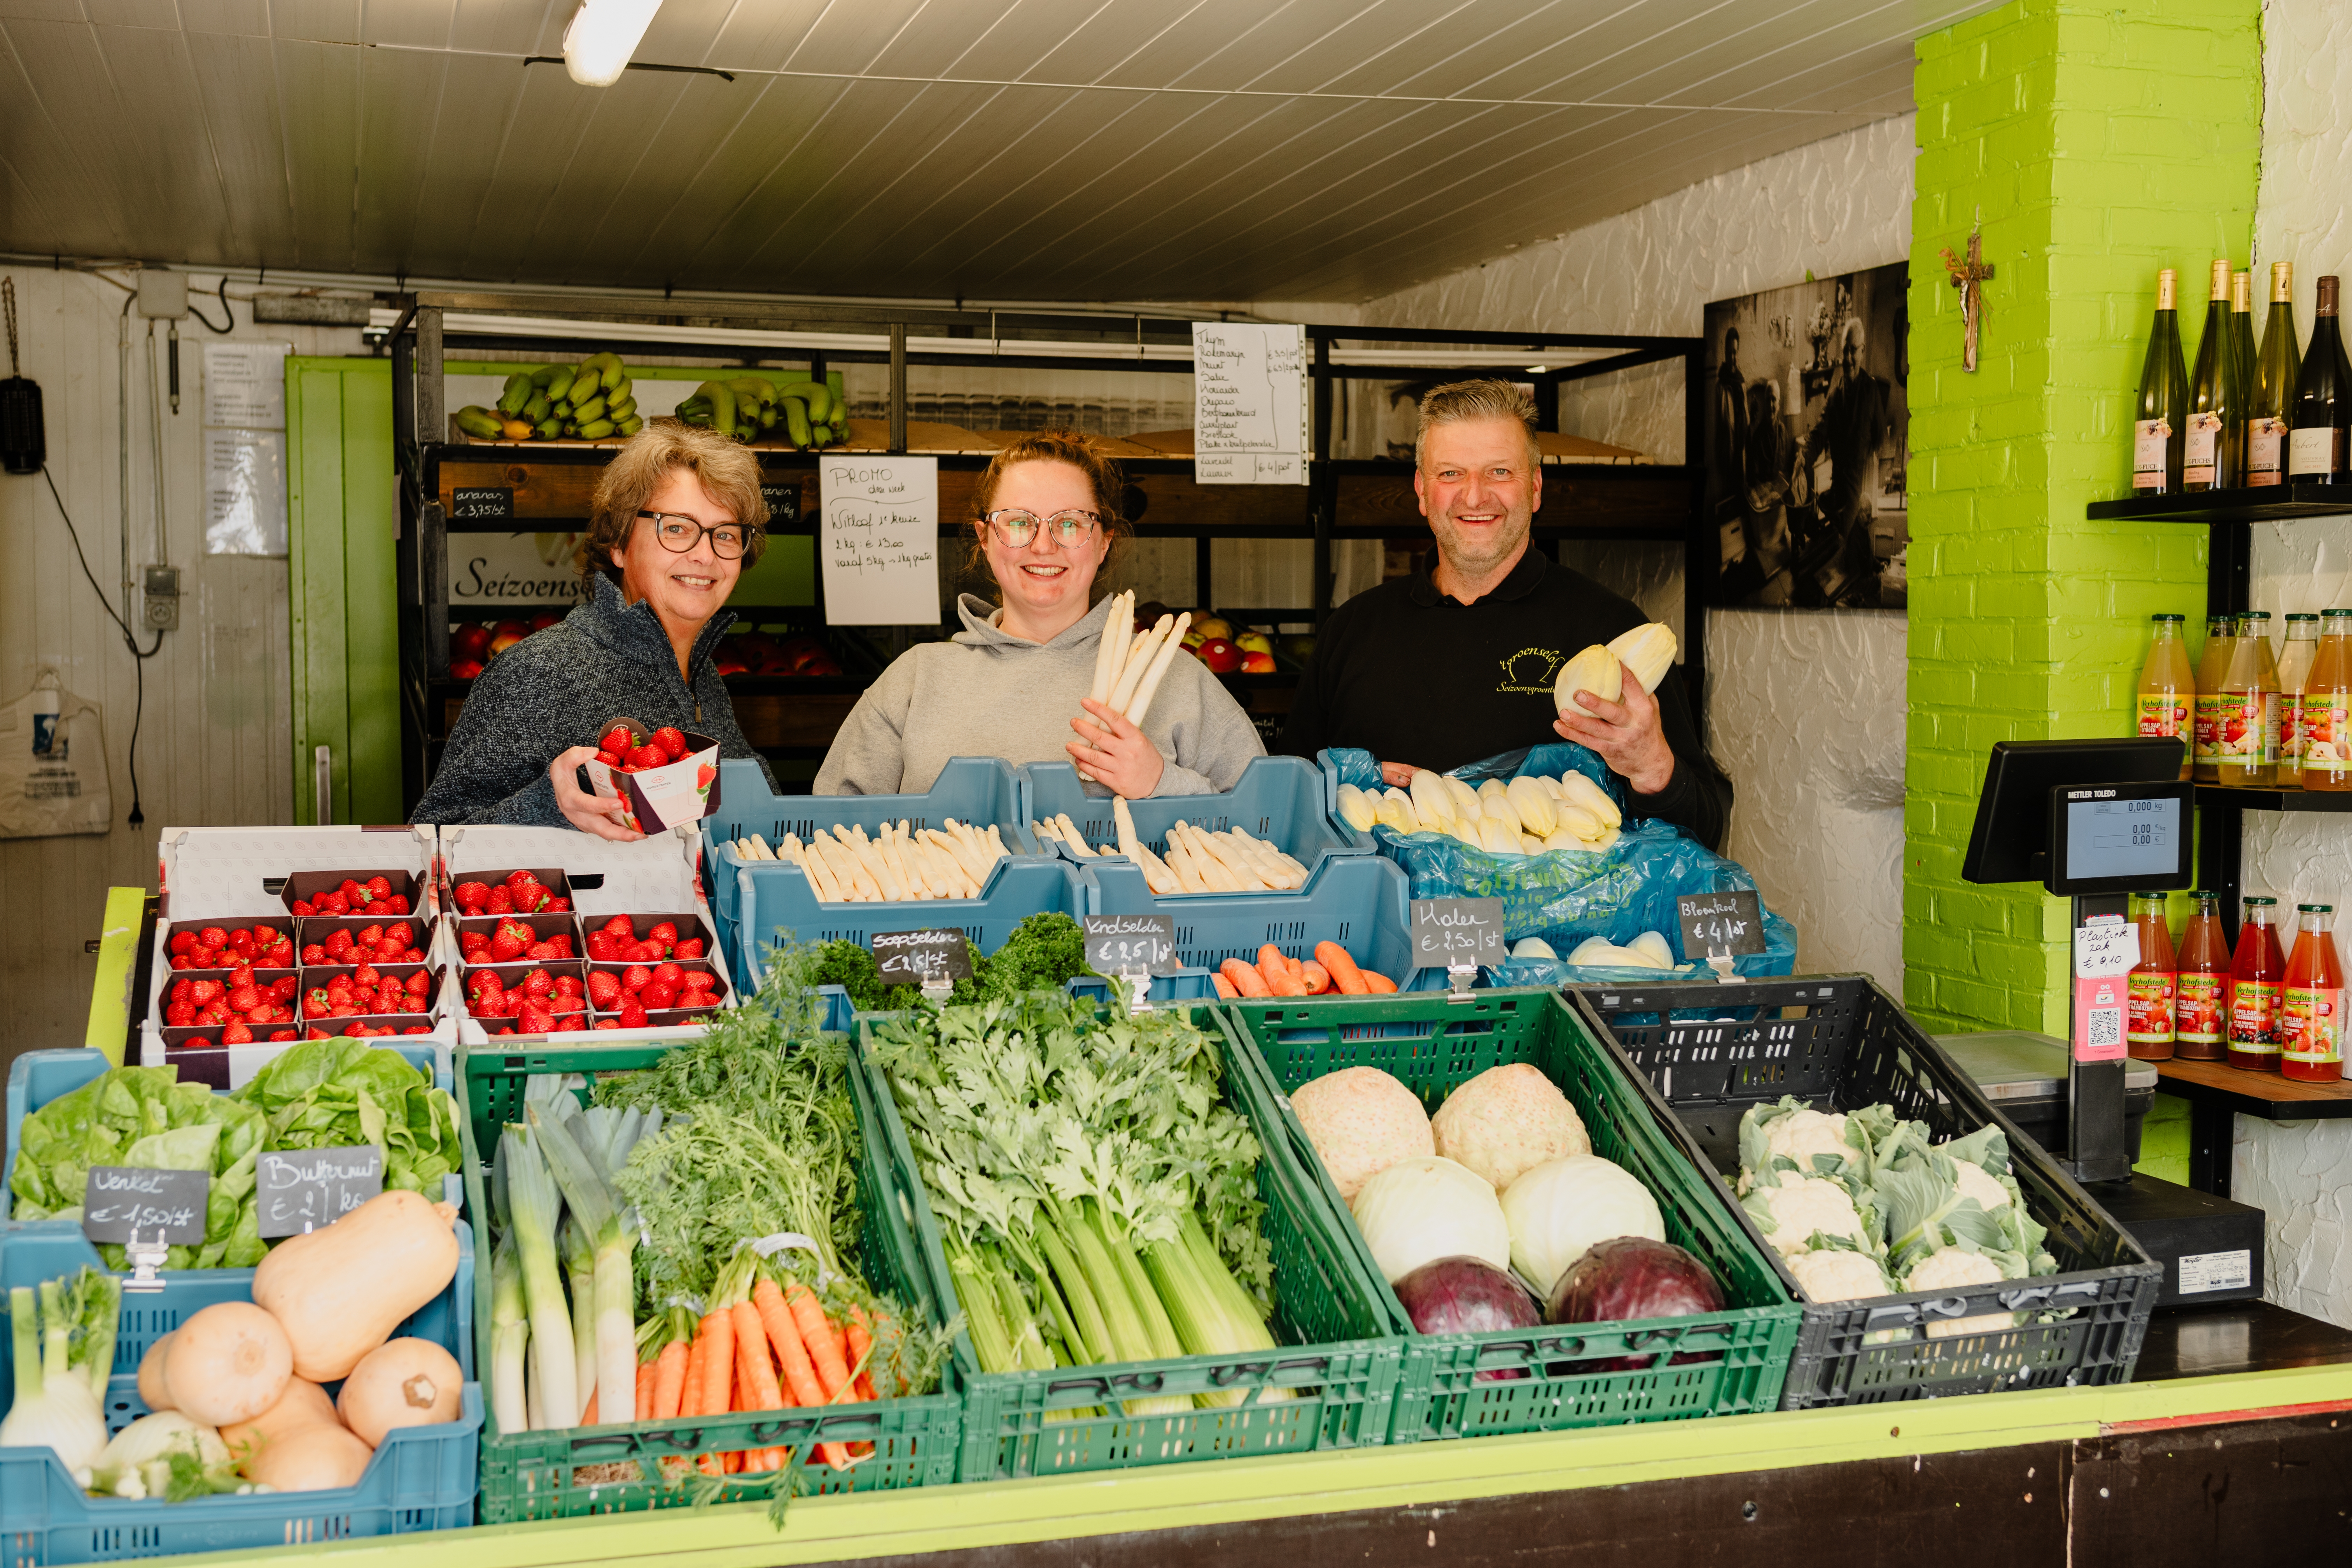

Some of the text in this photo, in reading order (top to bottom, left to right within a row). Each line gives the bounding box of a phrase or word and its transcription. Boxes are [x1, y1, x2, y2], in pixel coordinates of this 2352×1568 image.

[1200, 371, 1229, 381] Salie
[1200, 383, 1240, 394] Koriander
[830, 467, 892, 486] PROMO
[456, 492, 504, 500] ananas
[831, 509, 873, 536] Witloof
[2142, 700, 2177, 708] Verhofstede
[2129, 802, 2151, 812] 0,000
[2133, 824, 2151, 834] 0,00
[2133, 835, 2150, 845] 0,00
[1420, 902, 1489, 927] Kolen
[1085, 915, 1165, 934] Knolselder
[2078, 925, 2129, 942] Plastiek
[1421, 934, 1440, 952] €
[1098, 941, 1113, 961] €
[2083, 956, 2094, 968] €
[2130, 977, 2165, 988] Verhofstede
[2179, 977, 2214, 988] Verhofstede
[2237, 986, 2274, 995] Verhofstede
[2286, 992, 2320, 1002] Verhofstede
[264, 1155, 380, 1190] Butternut
[89, 1204, 121, 1222] €
[270, 1197, 296, 1221] €
